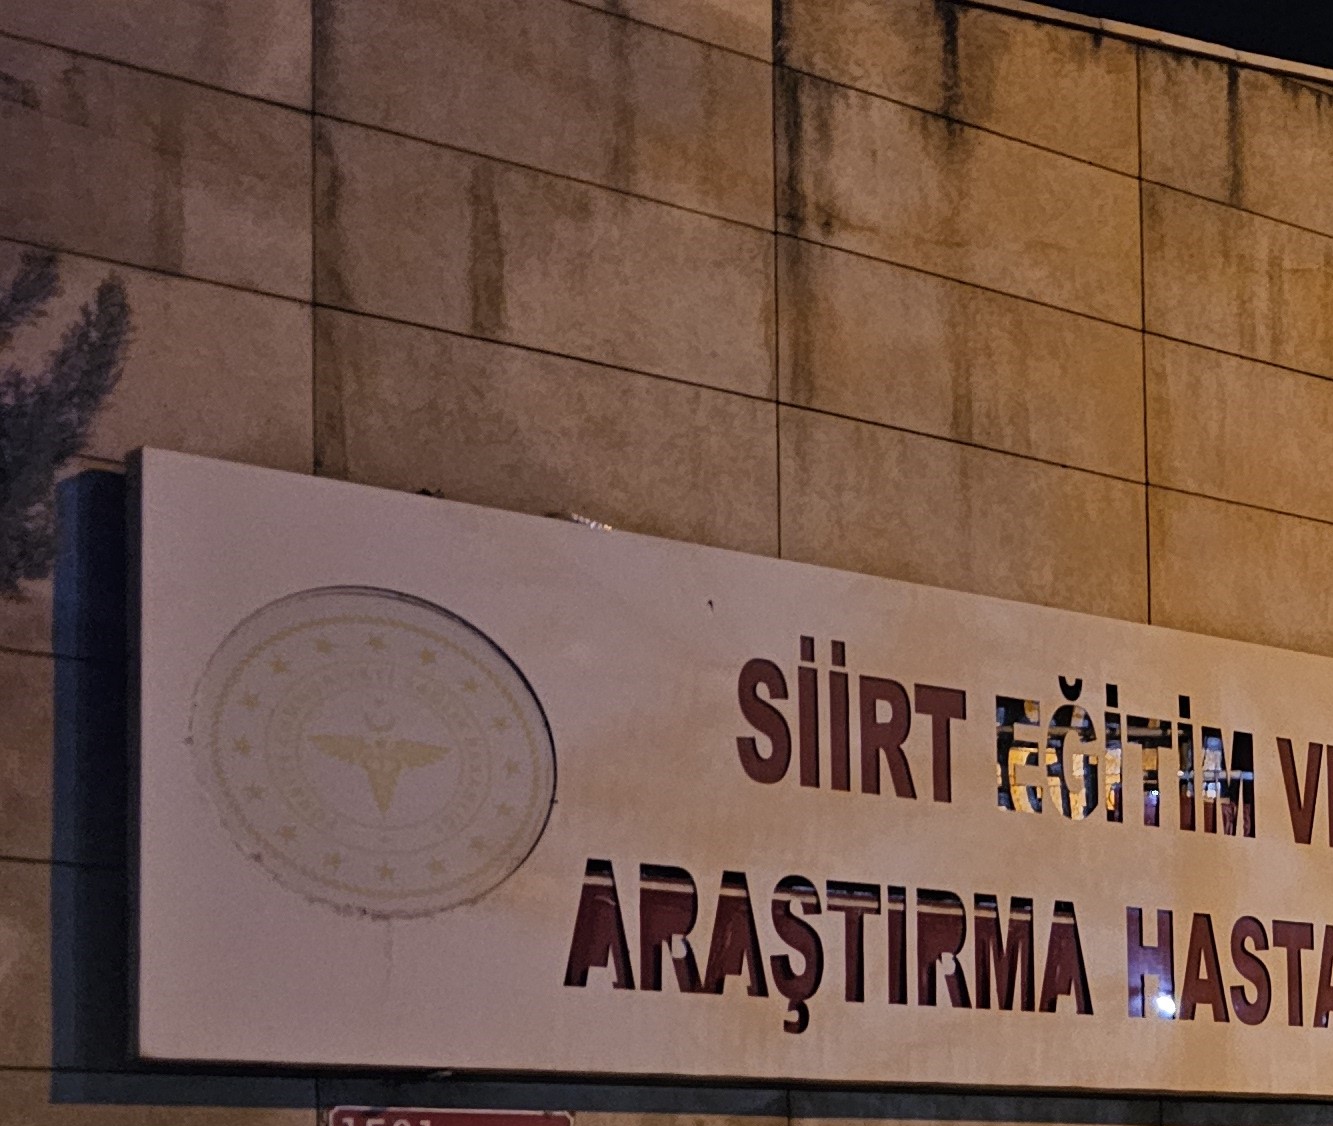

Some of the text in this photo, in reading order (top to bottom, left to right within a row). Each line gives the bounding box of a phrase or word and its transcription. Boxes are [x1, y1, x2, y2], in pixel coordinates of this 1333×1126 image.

[736, 635, 967, 803] SİİRT
[996, 676, 1256, 838] EĞİTİM
[564, 858, 1094, 1034] ARAŞTIRMA
